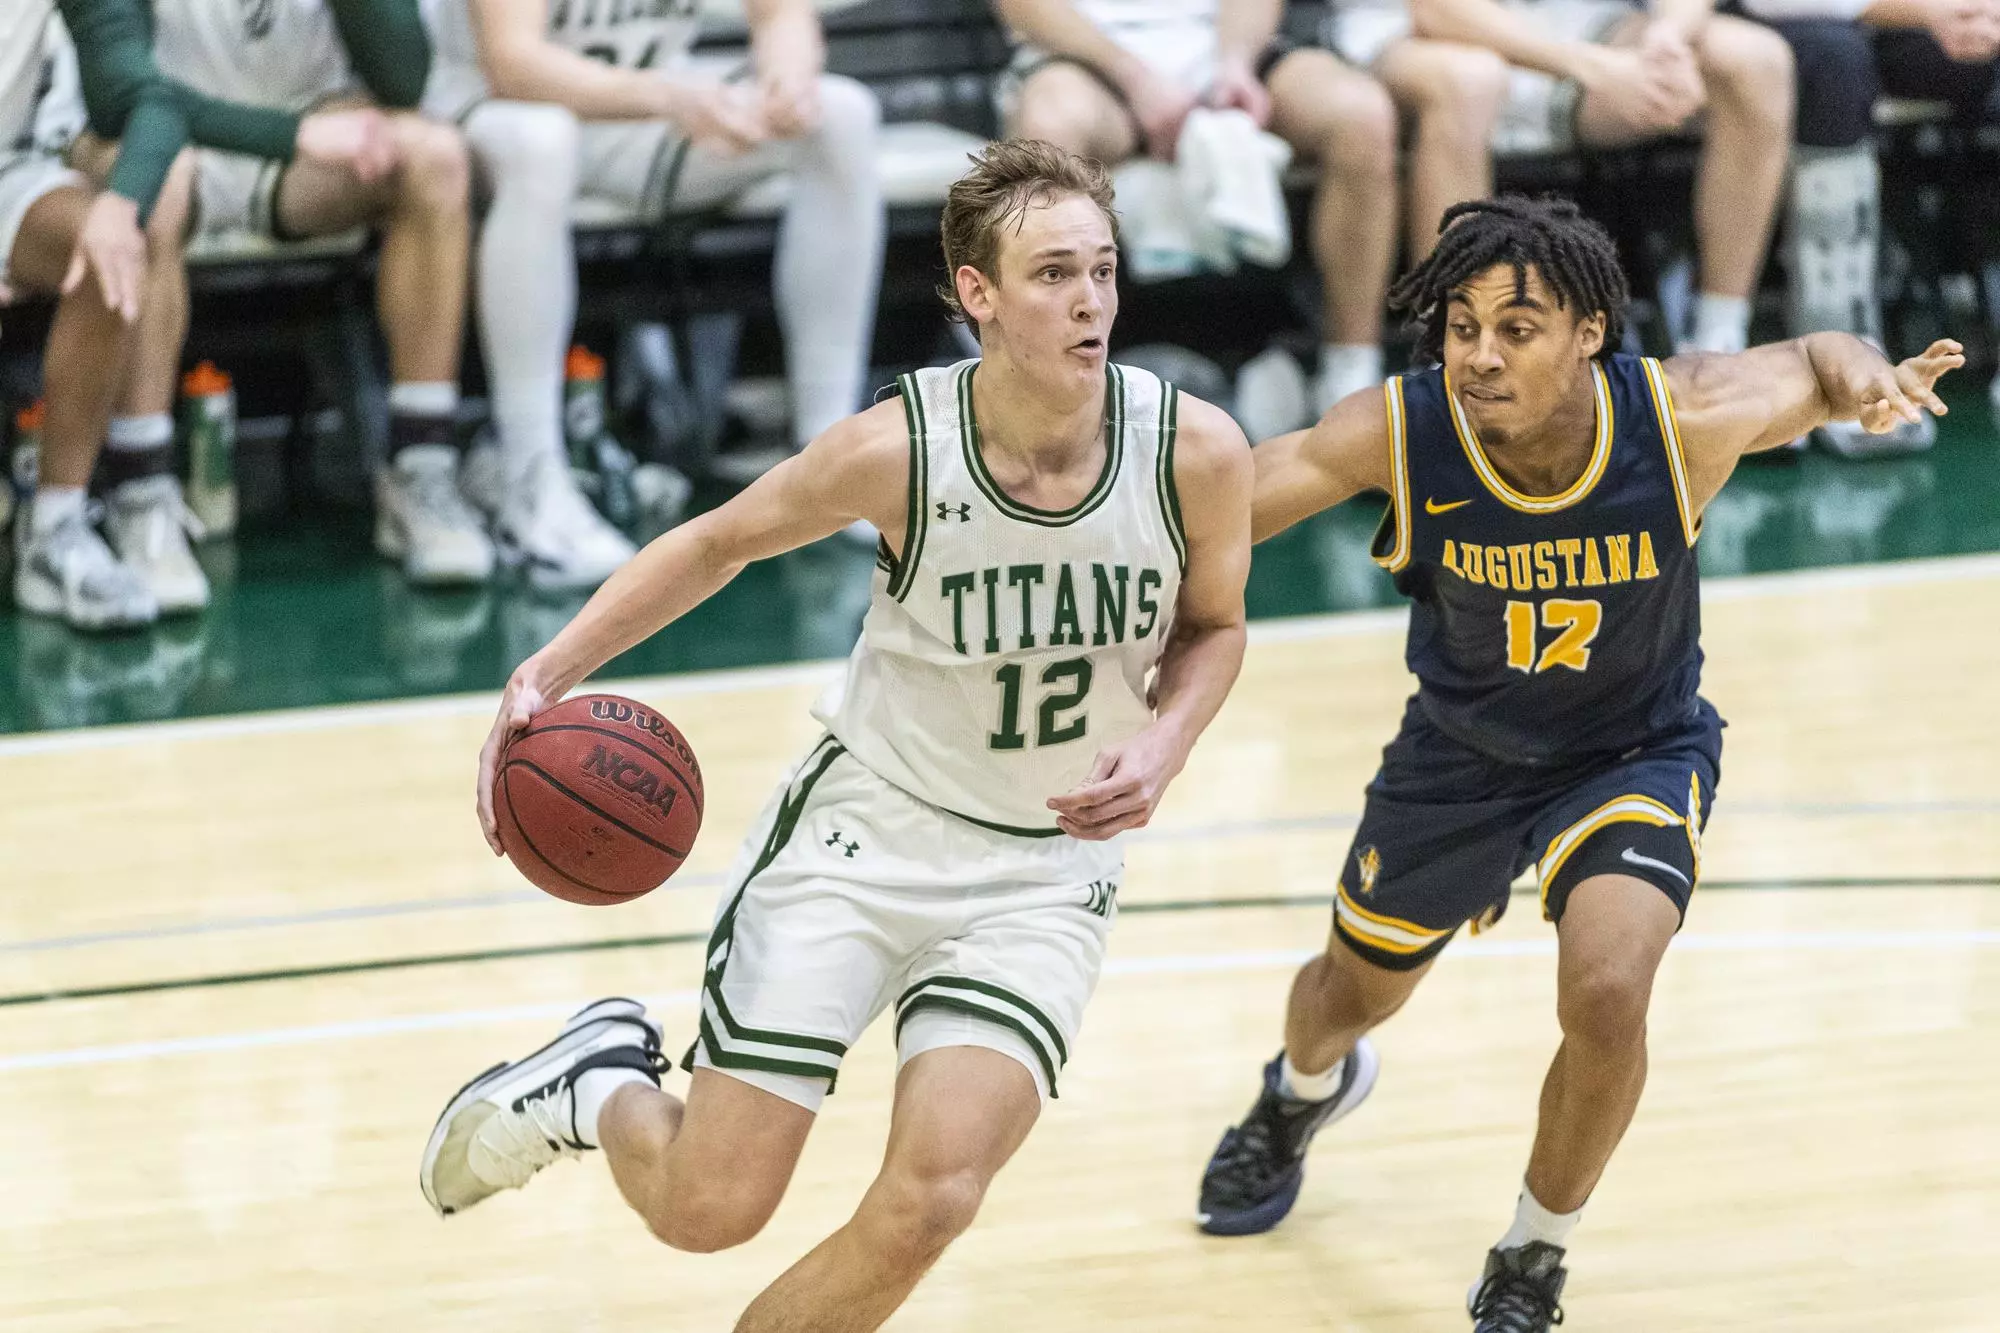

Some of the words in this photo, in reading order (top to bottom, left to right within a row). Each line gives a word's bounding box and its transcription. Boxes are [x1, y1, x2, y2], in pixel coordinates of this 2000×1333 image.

[1441, 530, 1660, 592] AUGUSTANA
[940, 562, 1163, 655] TITANS
[1503, 598, 1602, 674] 12
[988, 657, 1093, 750] 12
[581, 744, 677, 818] NCAA
